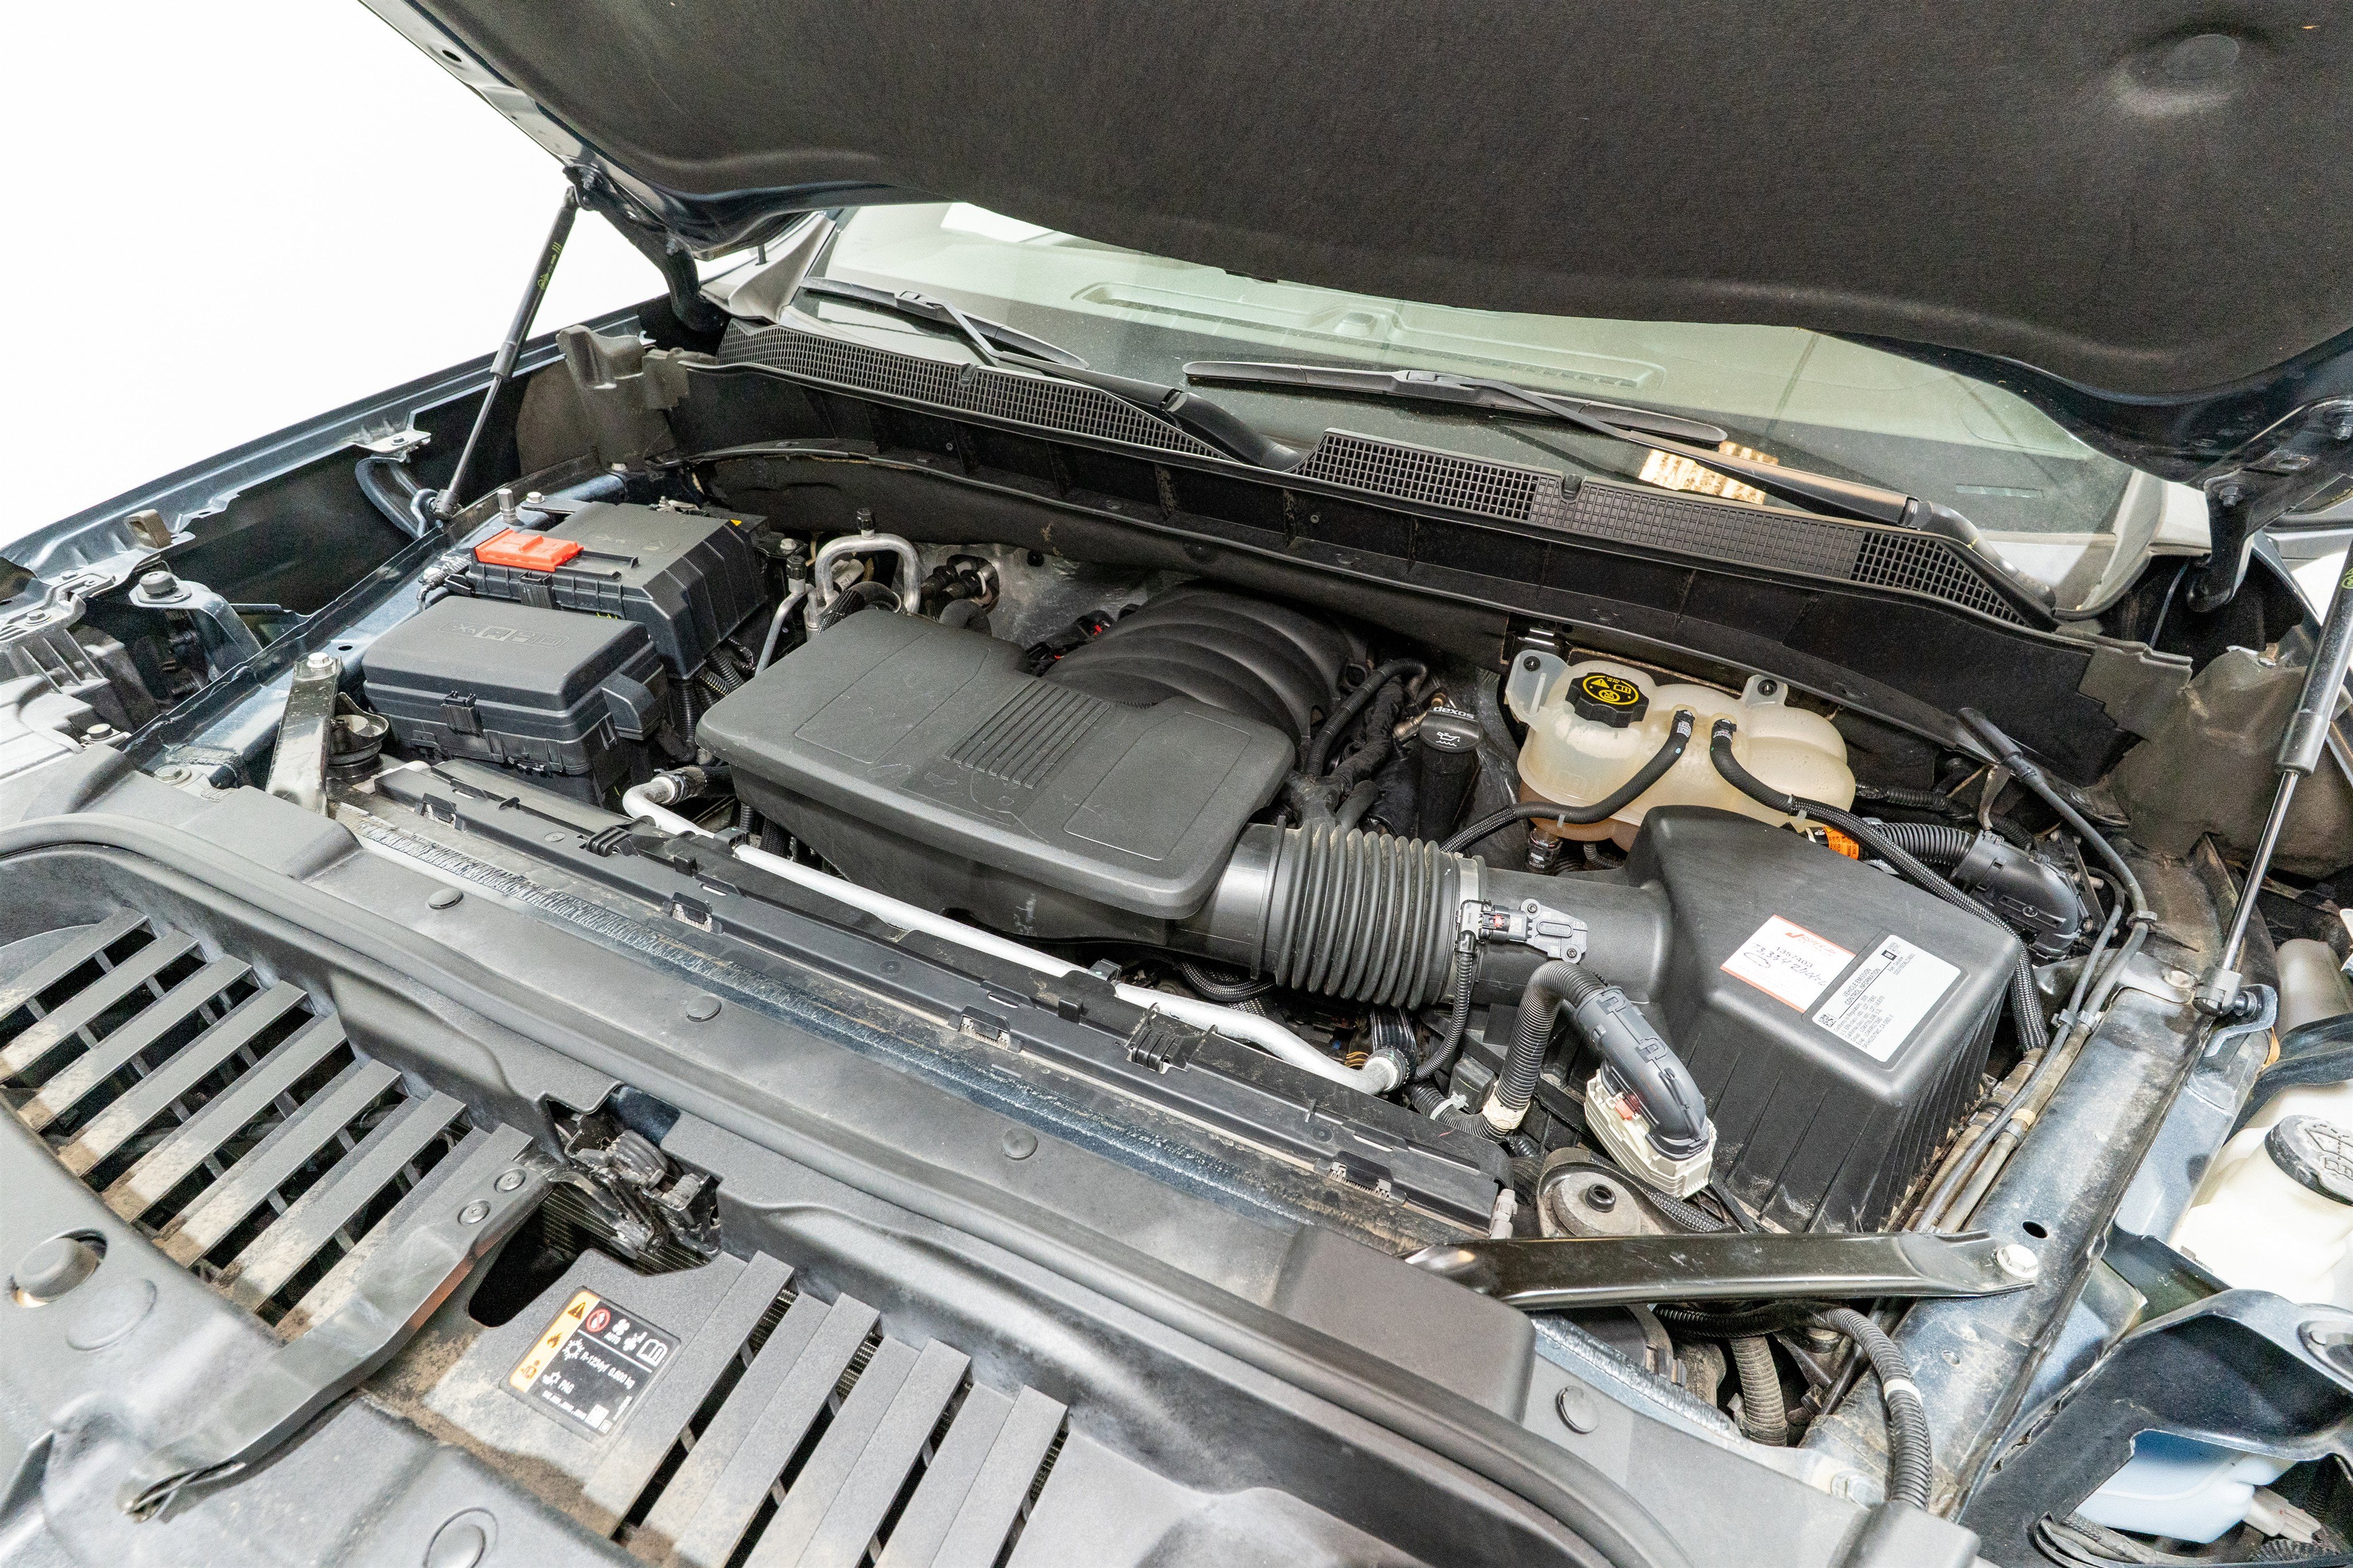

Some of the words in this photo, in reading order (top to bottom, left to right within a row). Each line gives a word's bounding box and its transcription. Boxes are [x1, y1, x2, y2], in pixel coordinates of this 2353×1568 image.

[1433, 706, 1475, 719] dexos
[1777, 947, 1813, 968] 1357403
[1843, 983, 1858, 997] VEHICLE
[1855, 968, 1872, 983] EMISSION
[1845, 990, 1862, 1005] CONTROL
[1859, 968, 1881, 989] INFORMATION
[604, 1331, 622, 1345] AUTO
[558, 1378, 576, 1395] PAG
[624, 1376, 635, 1390] kg
